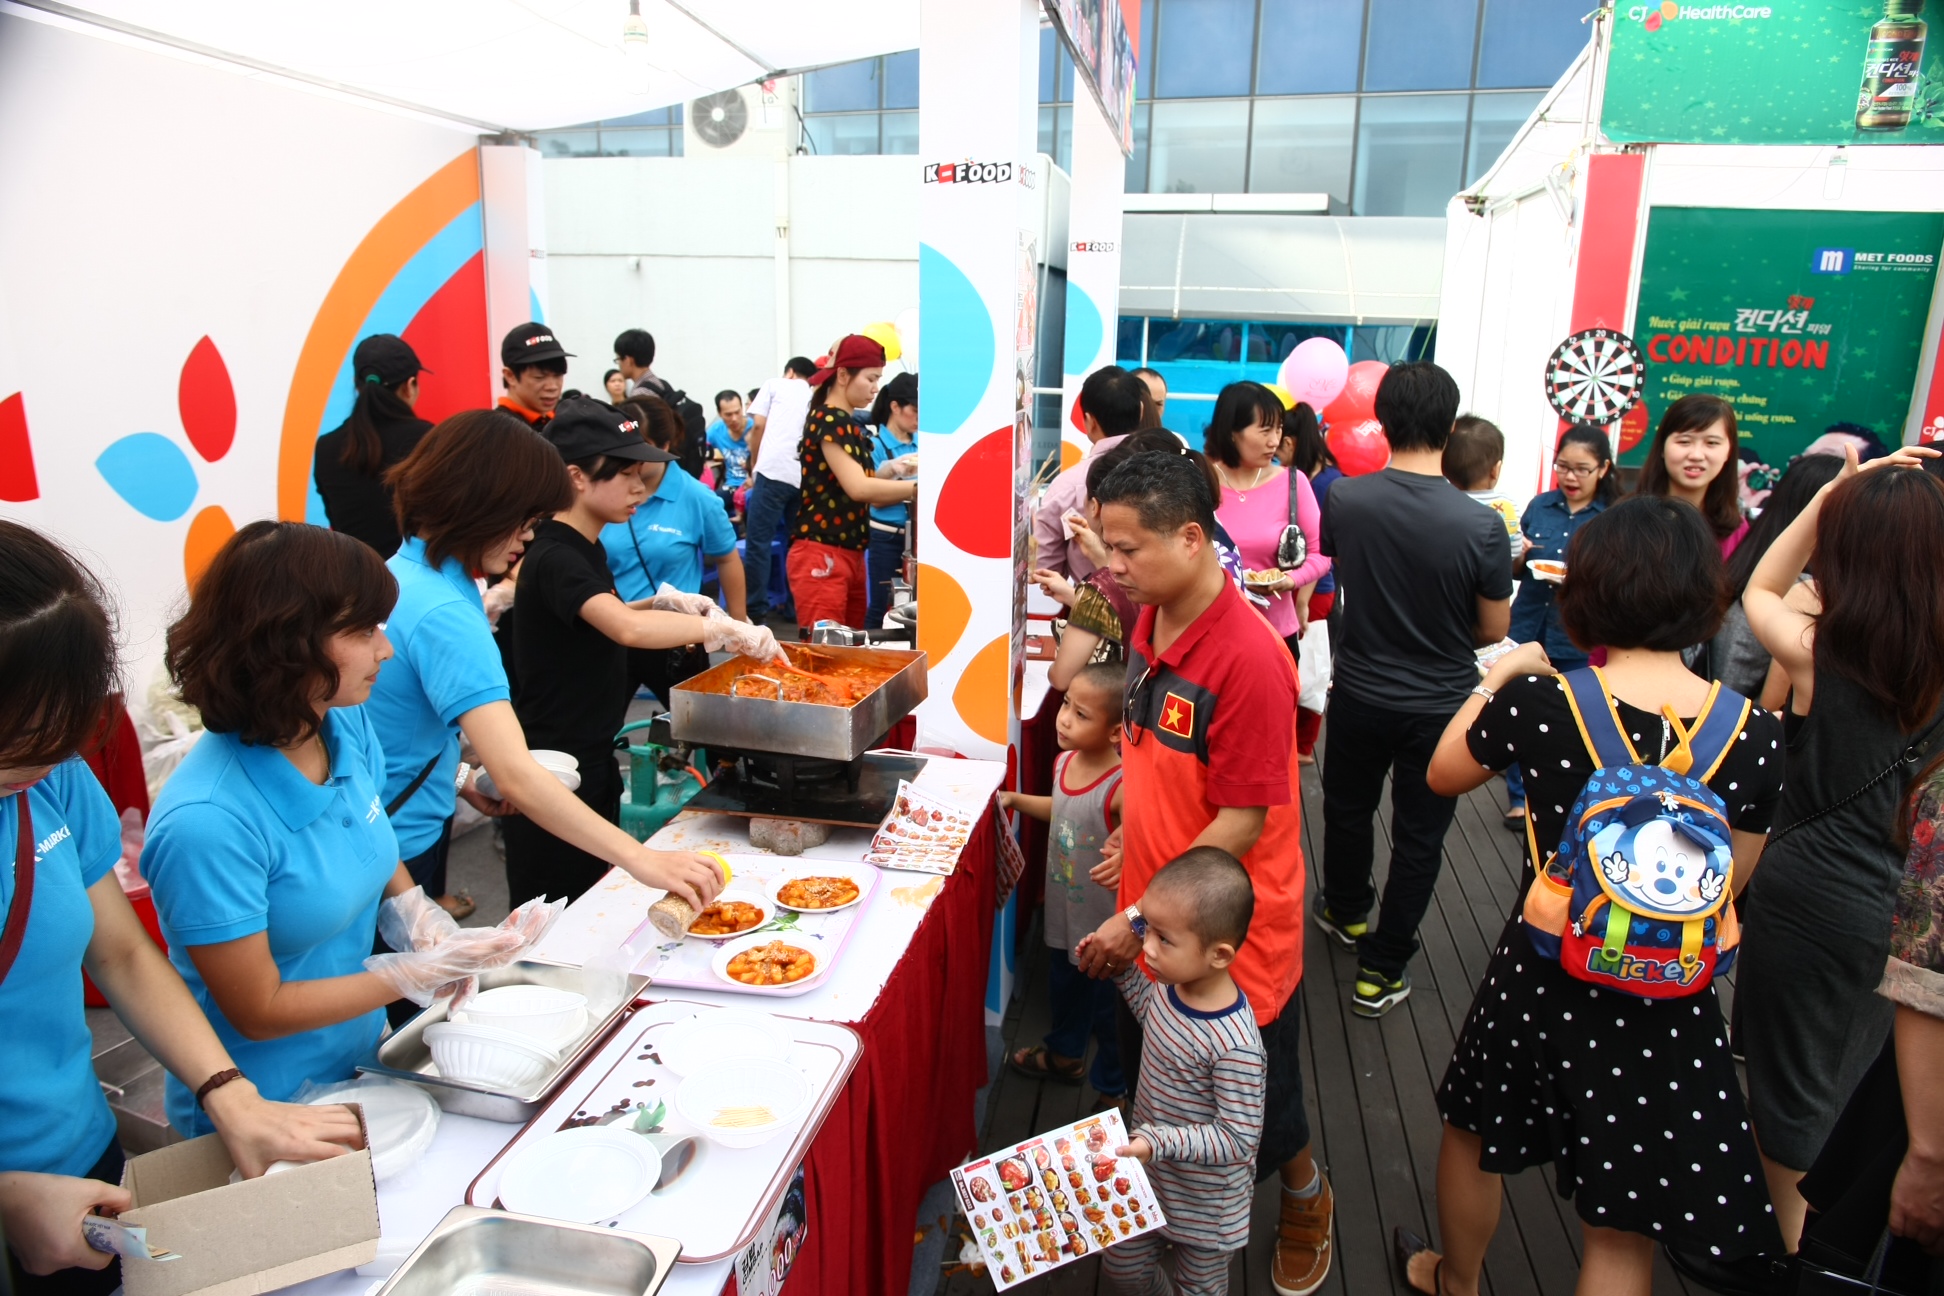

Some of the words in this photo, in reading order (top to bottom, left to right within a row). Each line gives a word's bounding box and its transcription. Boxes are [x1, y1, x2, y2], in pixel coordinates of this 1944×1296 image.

[1628, 6, 1649, 23] CJ
[1679, 5, 1772, 20] HealthCare
[1855, 252, 1884, 262] MET
[1887, 253, 1934, 264] FOODS
[1735, 308, 1809, 334] 컨디션
[1595, 330, 1607, 338] 20
[1647, 334, 1830, 369] CONDITION
[1922, 426, 1936, 437] CJ
[1589, 949, 1704, 985] Mickey
[742, 1242, 764, 1286] GIMBAP
